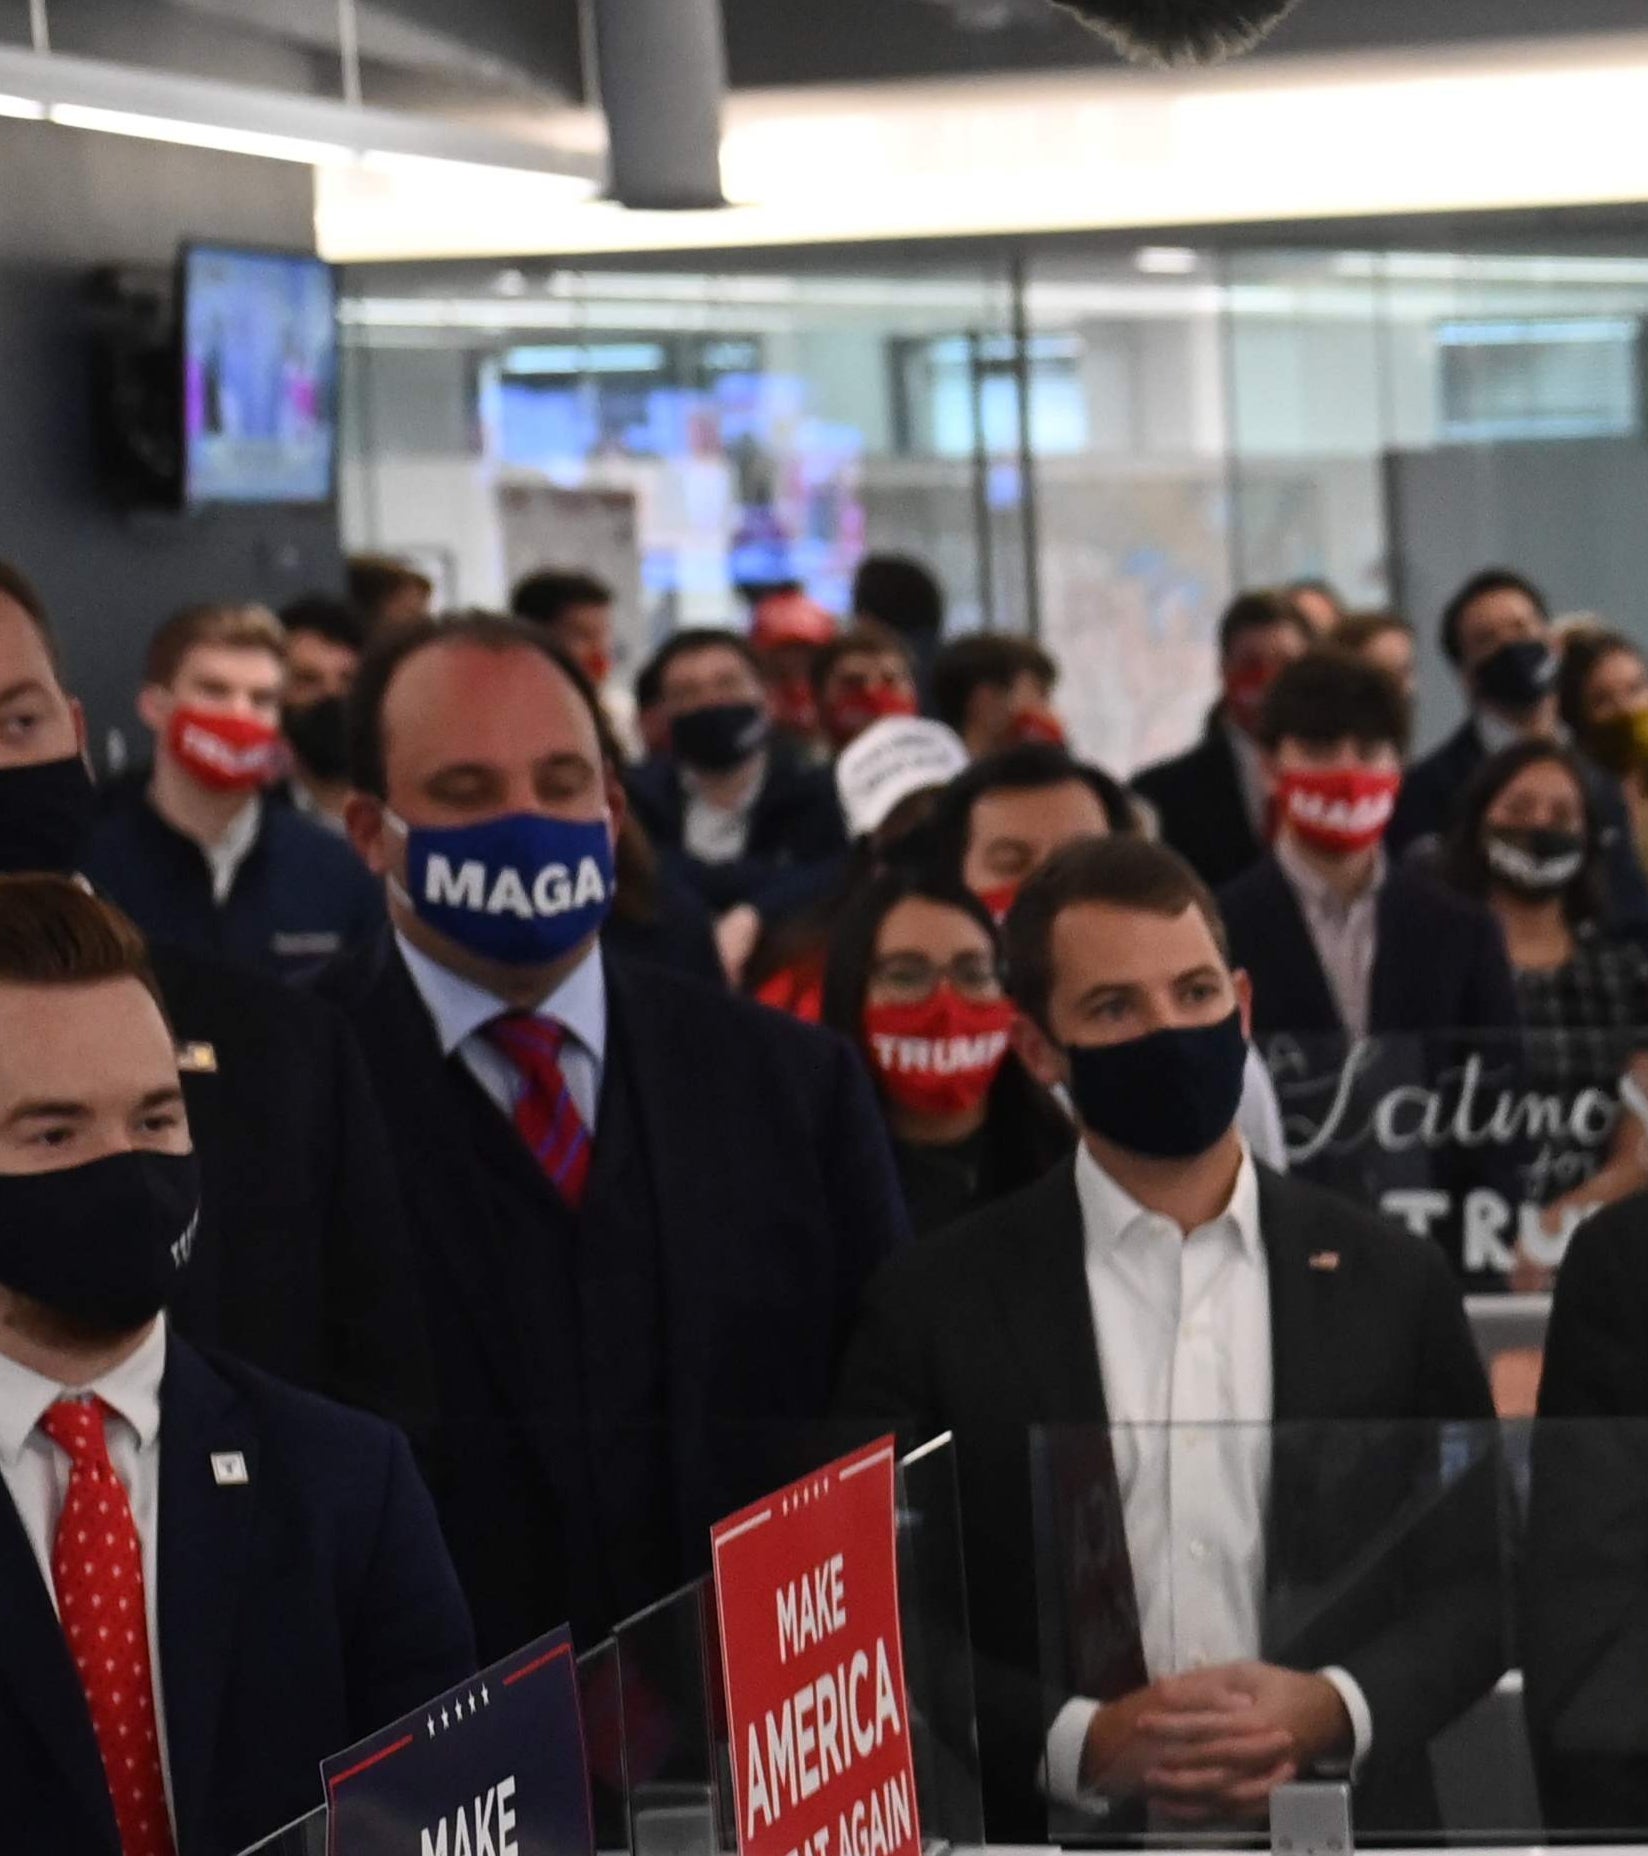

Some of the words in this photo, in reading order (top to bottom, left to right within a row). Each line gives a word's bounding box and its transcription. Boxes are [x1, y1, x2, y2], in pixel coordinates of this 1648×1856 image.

[425, 853, 606, 920] MAGA
[776, 1553, 846, 1663] MAKE
[747, 1636, 901, 1841] AMERICA
